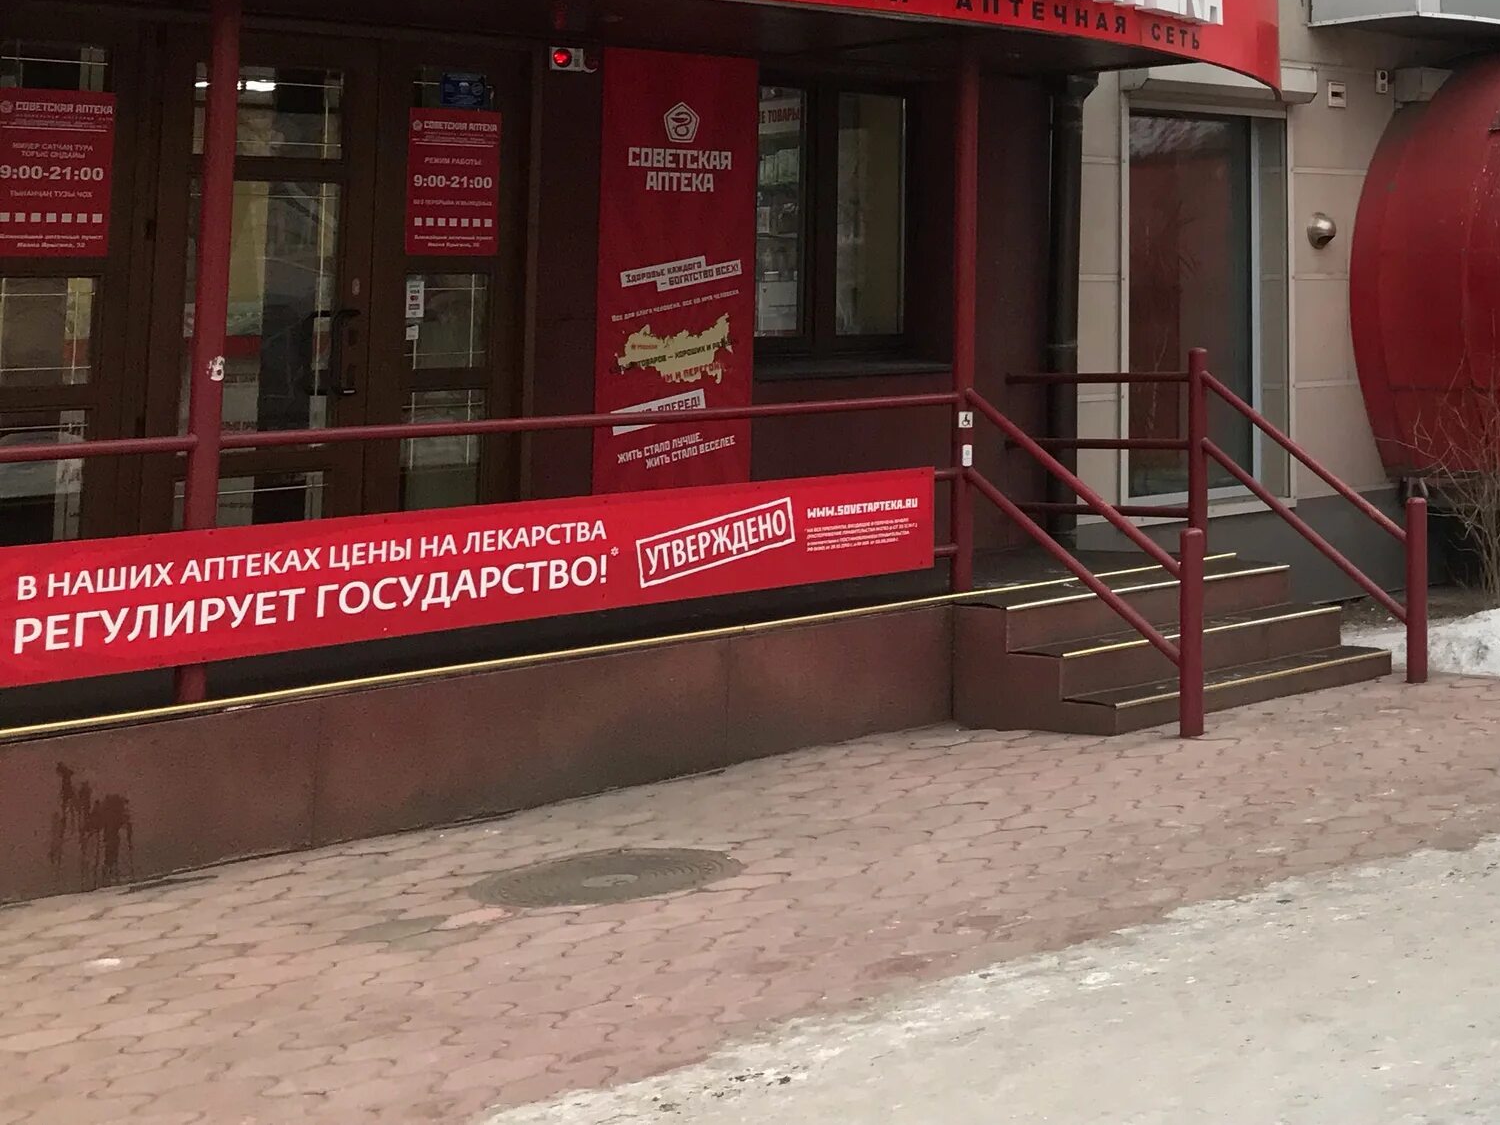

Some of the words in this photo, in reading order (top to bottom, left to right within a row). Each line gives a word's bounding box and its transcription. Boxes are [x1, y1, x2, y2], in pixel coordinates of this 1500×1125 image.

[1151, 23, 1200, 51] СЕТЬ
[15, 101, 73, 113] СОВЕТСКАЯ
[75, 104, 113, 115] АПТЕКА
[628, 147, 732, 170] СОВЕТСКАЯ
[0, 165, 104, 181] 9:00-21:00
[413, 175, 493, 189] 9:00-21:00
[645, 171, 714, 192] АПТЕКА
[669, 270, 714, 286] БОГАТСТВО
[716, 263, 739, 276] ВСЕХ!
[617, 449, 643, 463] ЖИТЬ
[644, 441, 671, 457] СТАЛО
[645, 455, 671, 469] ЖИТЬ
[672, 446, 699, 462] СТАЛО
[700, 435, 736, 454] ВЕСЕЛЕЕ
[806, 498, 918, 518] WWW.SOVETAPTEKA.RU
[643, 508, 787, 576] УТВЕРЖДЕНО
[17, 575, 37, 601] В
[47, 561, 175, 598] НАШИХ
[180, 547, 321, 585] АПТЕКАХ
[329, 537, 412, 571] ЦЕНЫ
[419, 533, 457, 559] НА
[462, 519, 607, 554] ЛЕКАРСТВА
[13, 587, 305, 655] РЕГУЛИРУЕТ
